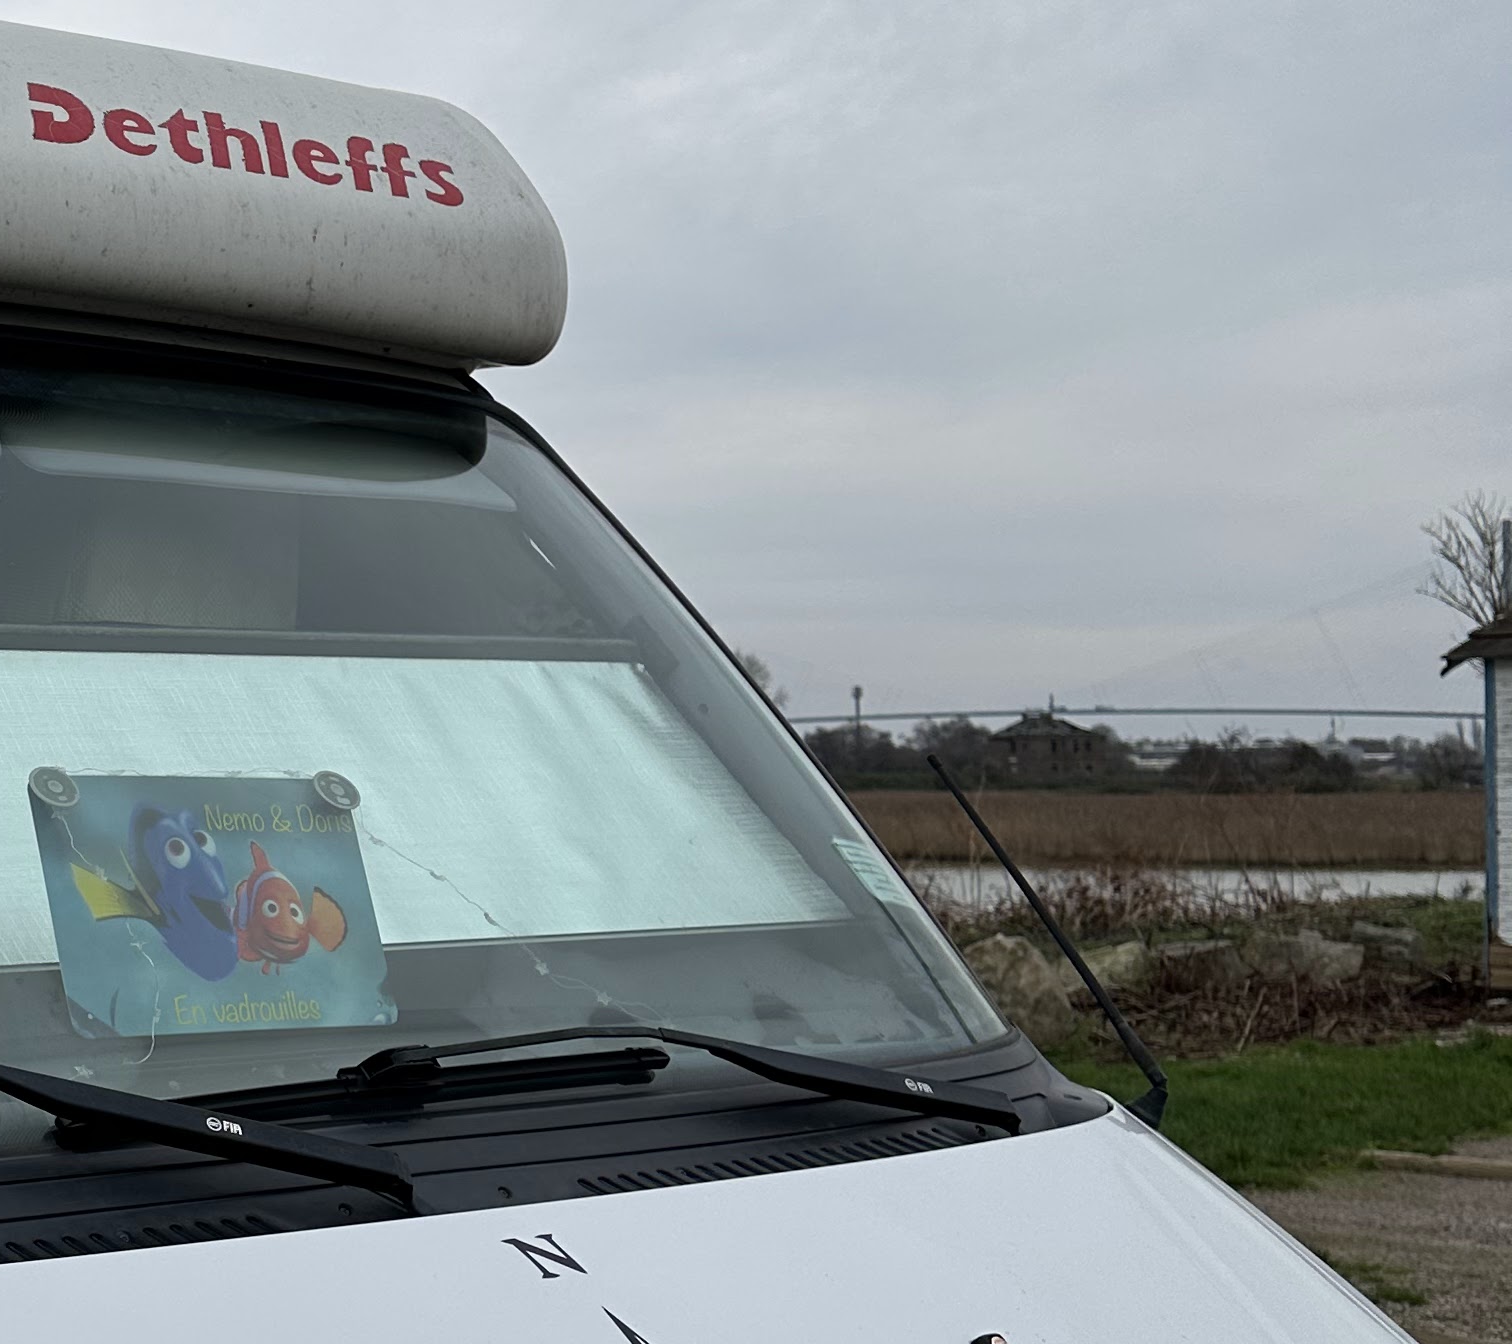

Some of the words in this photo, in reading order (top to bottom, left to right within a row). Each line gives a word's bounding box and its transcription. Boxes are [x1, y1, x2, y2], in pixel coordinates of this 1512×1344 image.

[26, 81, 465, 207] Dethleffs
[202, 803, 265, 834] Nemo
[270, 804, 294, 833] &
[294, 803, 353, 834] Doris
[173, 994, 208, 1026] En
[212, 990, 322, 1023] vadrouilles
[501, 1233, 588, 1279] N
